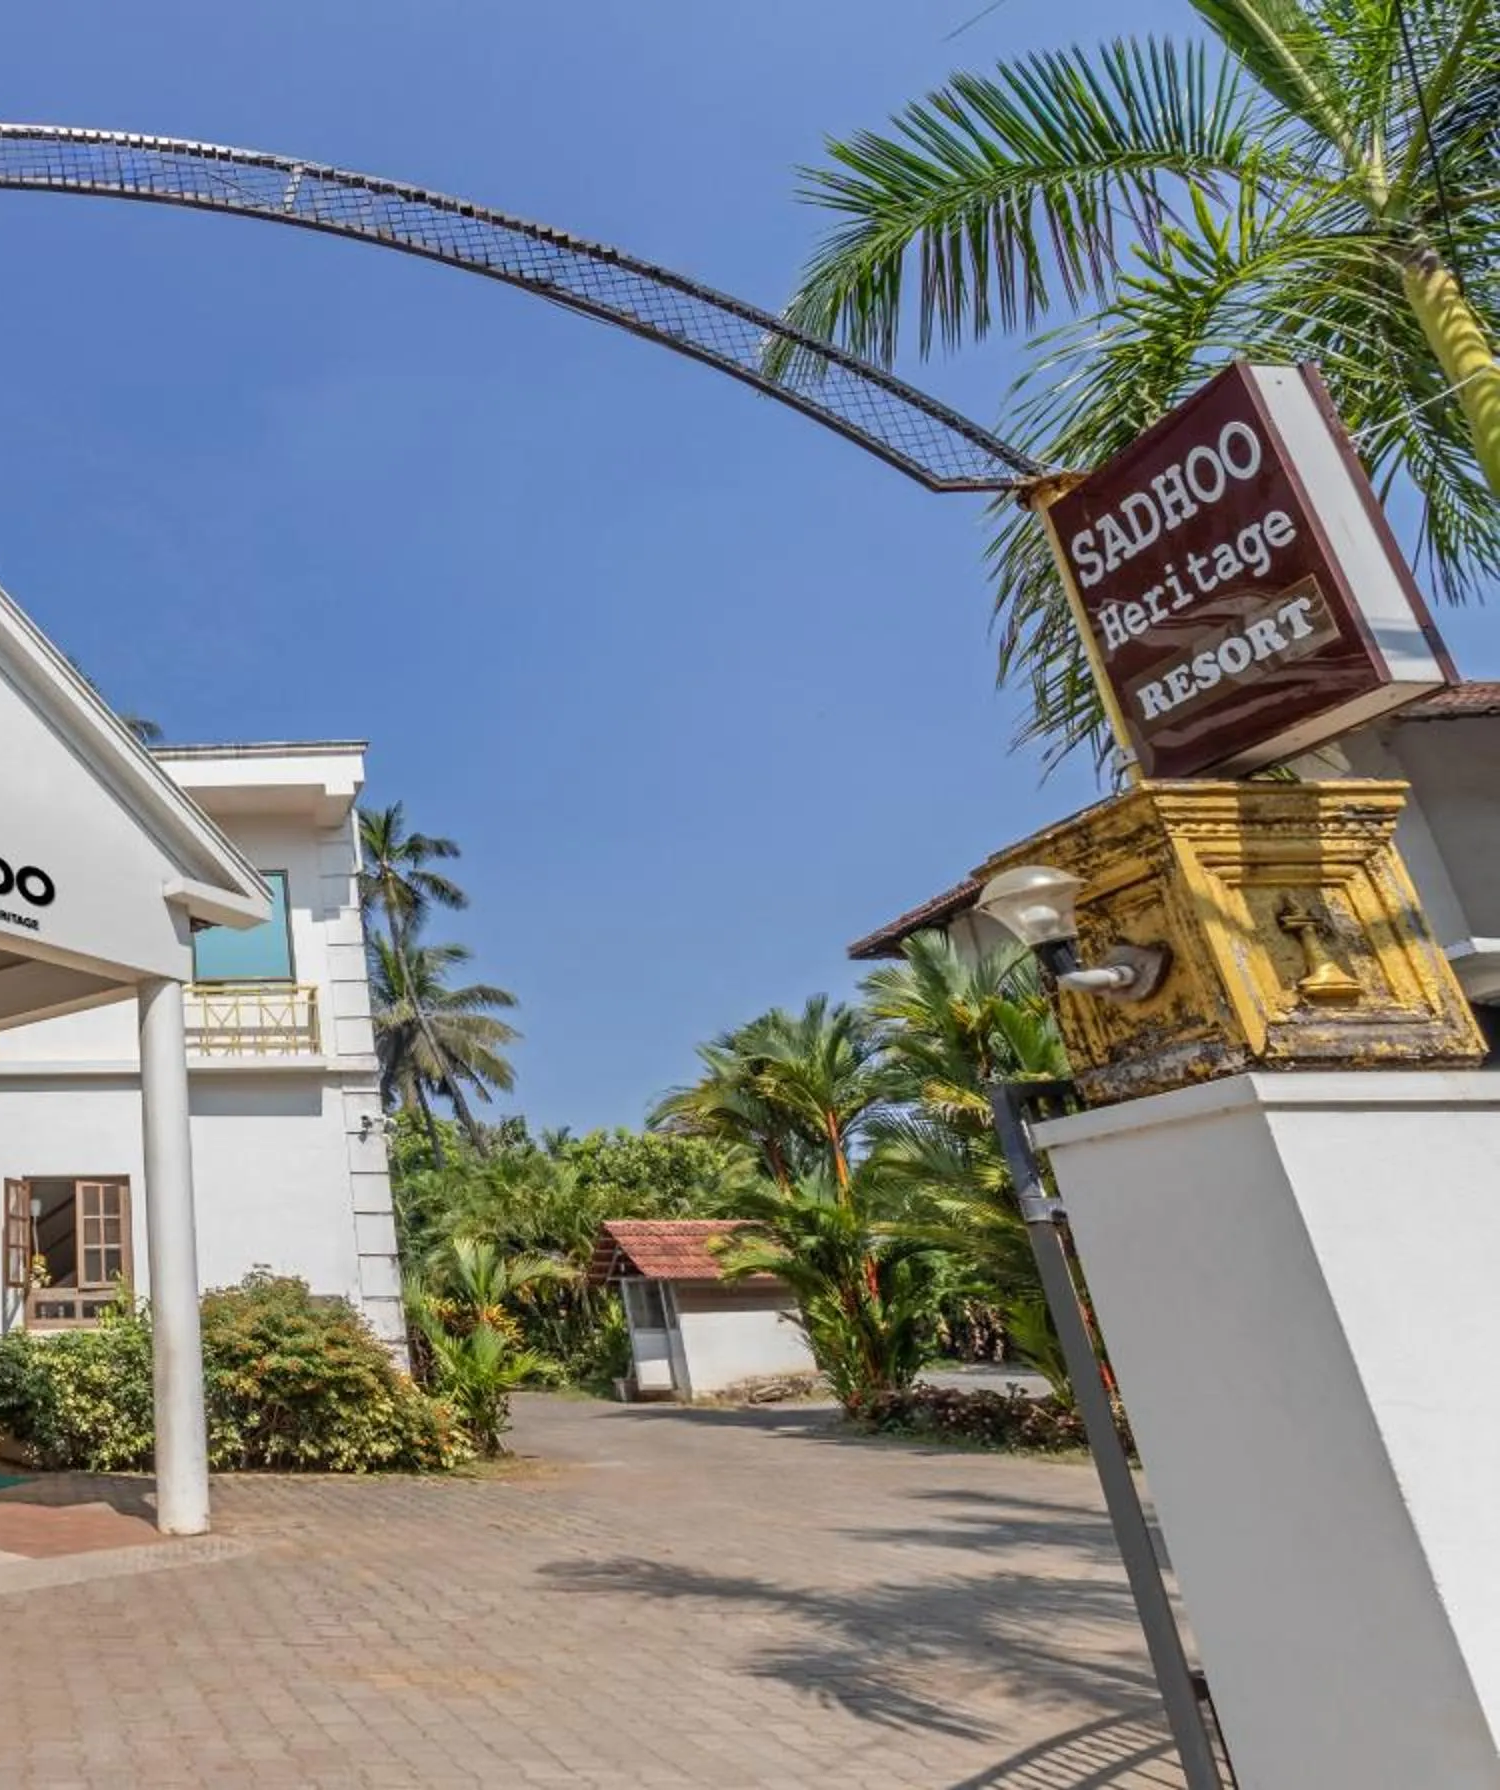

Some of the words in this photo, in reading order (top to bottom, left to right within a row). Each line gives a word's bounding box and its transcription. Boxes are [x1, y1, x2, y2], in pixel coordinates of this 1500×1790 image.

[1071, 420, 1262, 589] SADHOO
[1096, 509, 1297, 651] Heritage
[1135, 596, 1315, 721] RESORT
